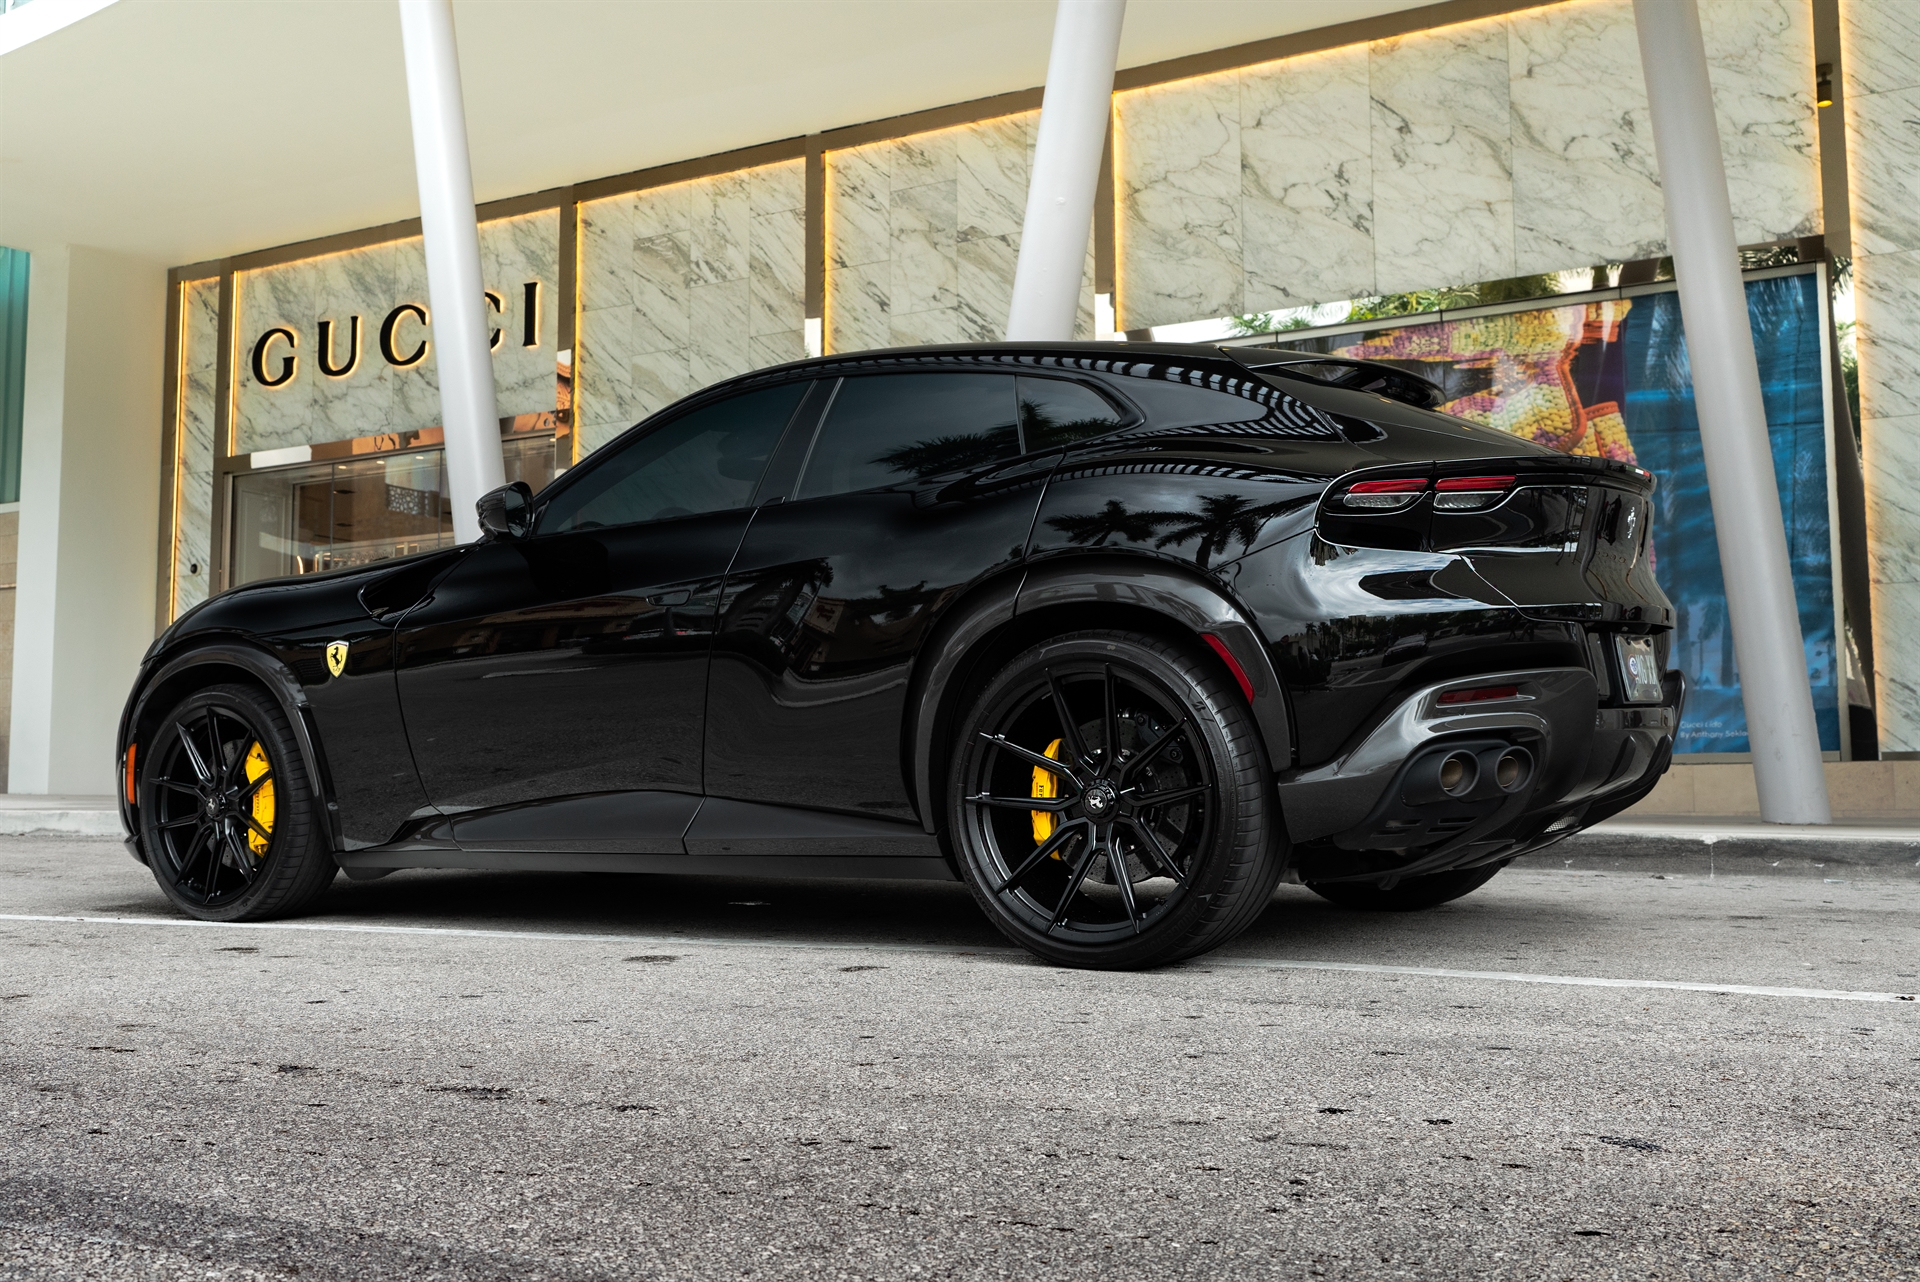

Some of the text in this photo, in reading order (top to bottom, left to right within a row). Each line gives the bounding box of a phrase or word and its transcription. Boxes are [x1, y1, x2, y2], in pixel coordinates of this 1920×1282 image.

[1680, 720, 1723, 729] Gucci Lido
[1680, 731, 1690, 740] By
[1691, 730, 1724, 739] Anthony
